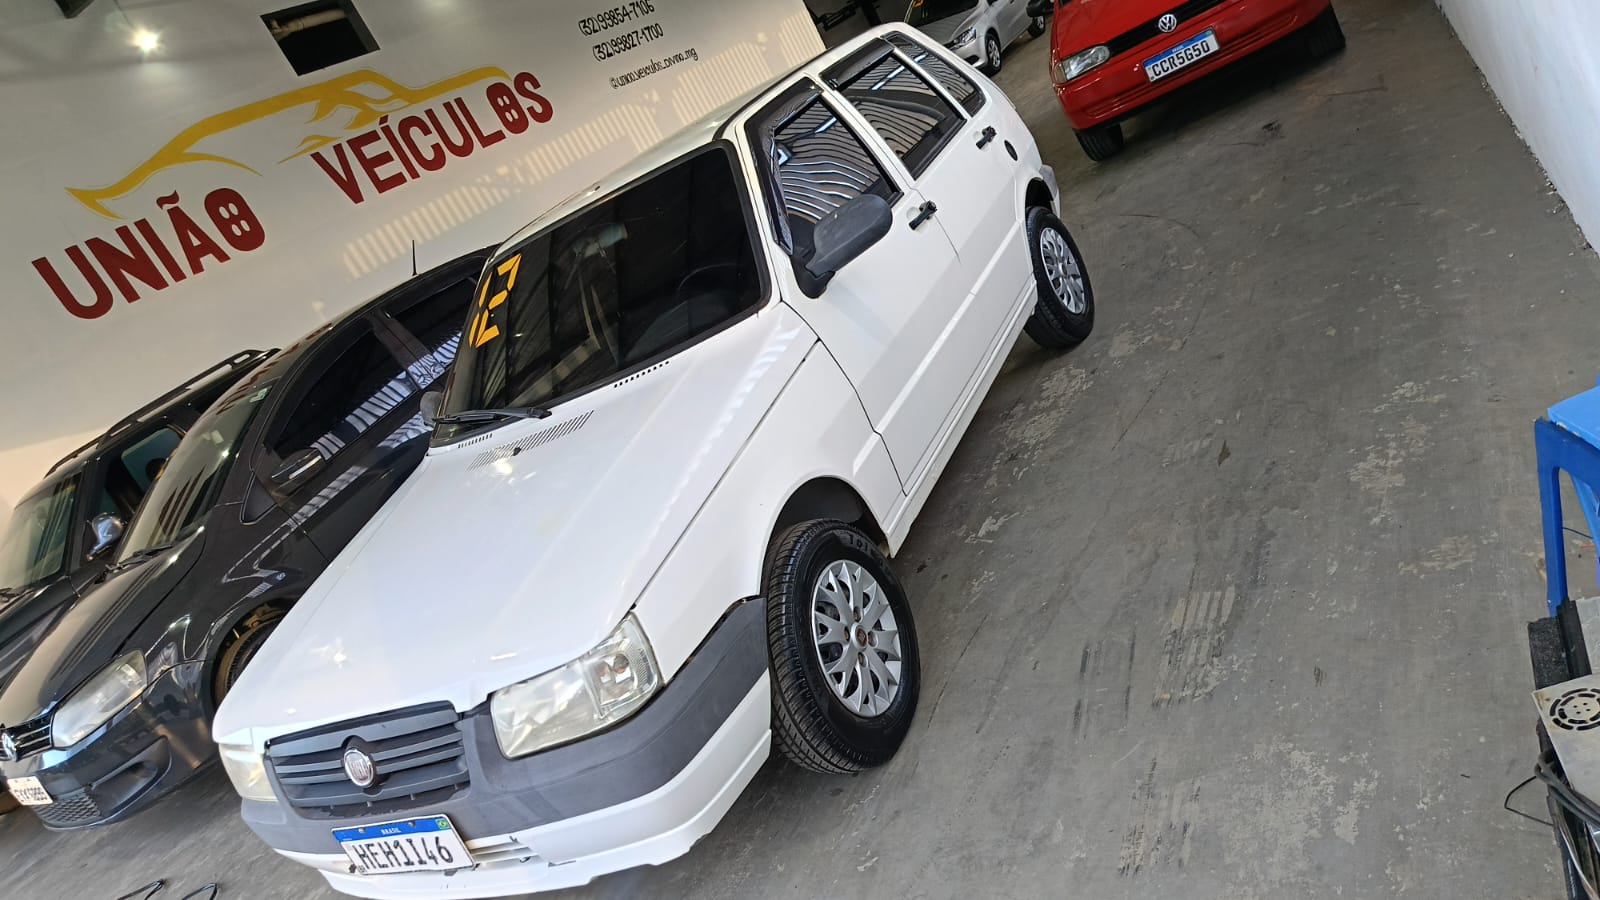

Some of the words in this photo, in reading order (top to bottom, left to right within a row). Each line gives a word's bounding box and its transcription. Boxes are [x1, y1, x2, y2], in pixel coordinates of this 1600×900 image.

[592, 22, 664, 62] (32)99827-1700
[1151, 40, 1210, 77] CCR5G50
[31, 187, 266, 320] UNIÃO
[310, 71, 554, 205] VEÍCULOS
